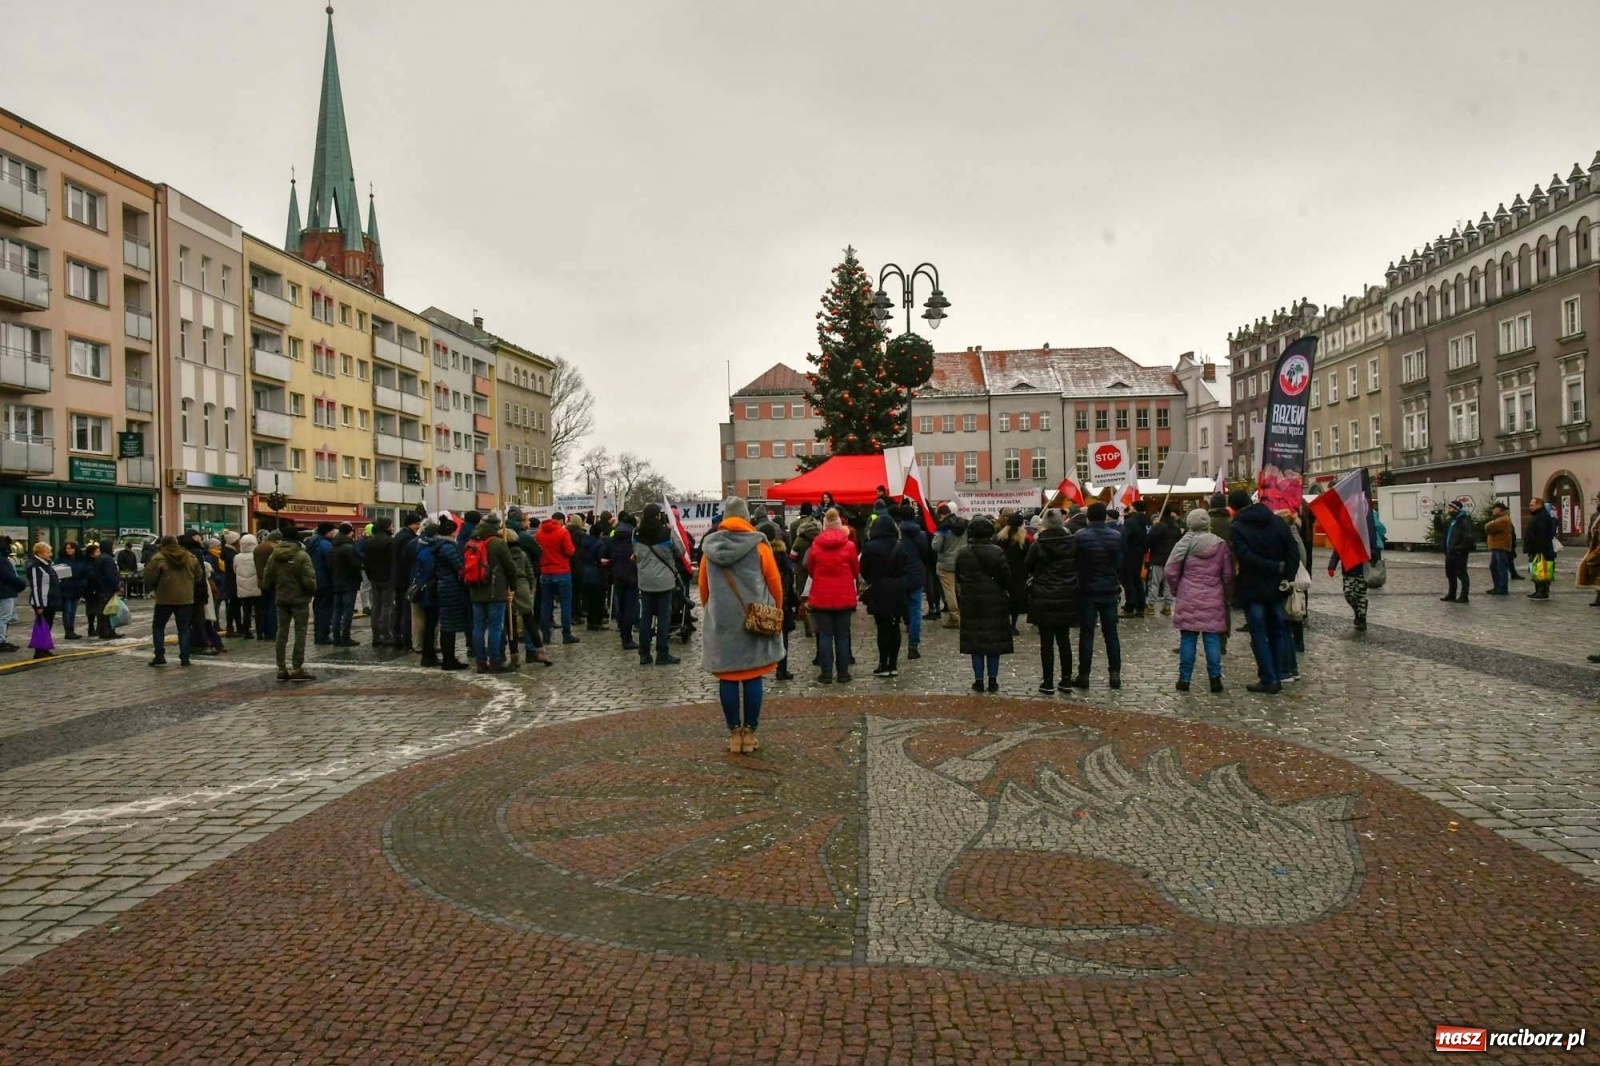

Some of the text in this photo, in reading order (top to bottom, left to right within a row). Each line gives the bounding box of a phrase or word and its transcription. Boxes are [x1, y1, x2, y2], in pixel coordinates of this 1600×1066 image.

[1272, 404, 1306, 425] RAZEM
[1095, 452, 1120, 462] STOP
[21, 494, 95, 510] JUBILER
[695, 503, 719, 518] NIE
